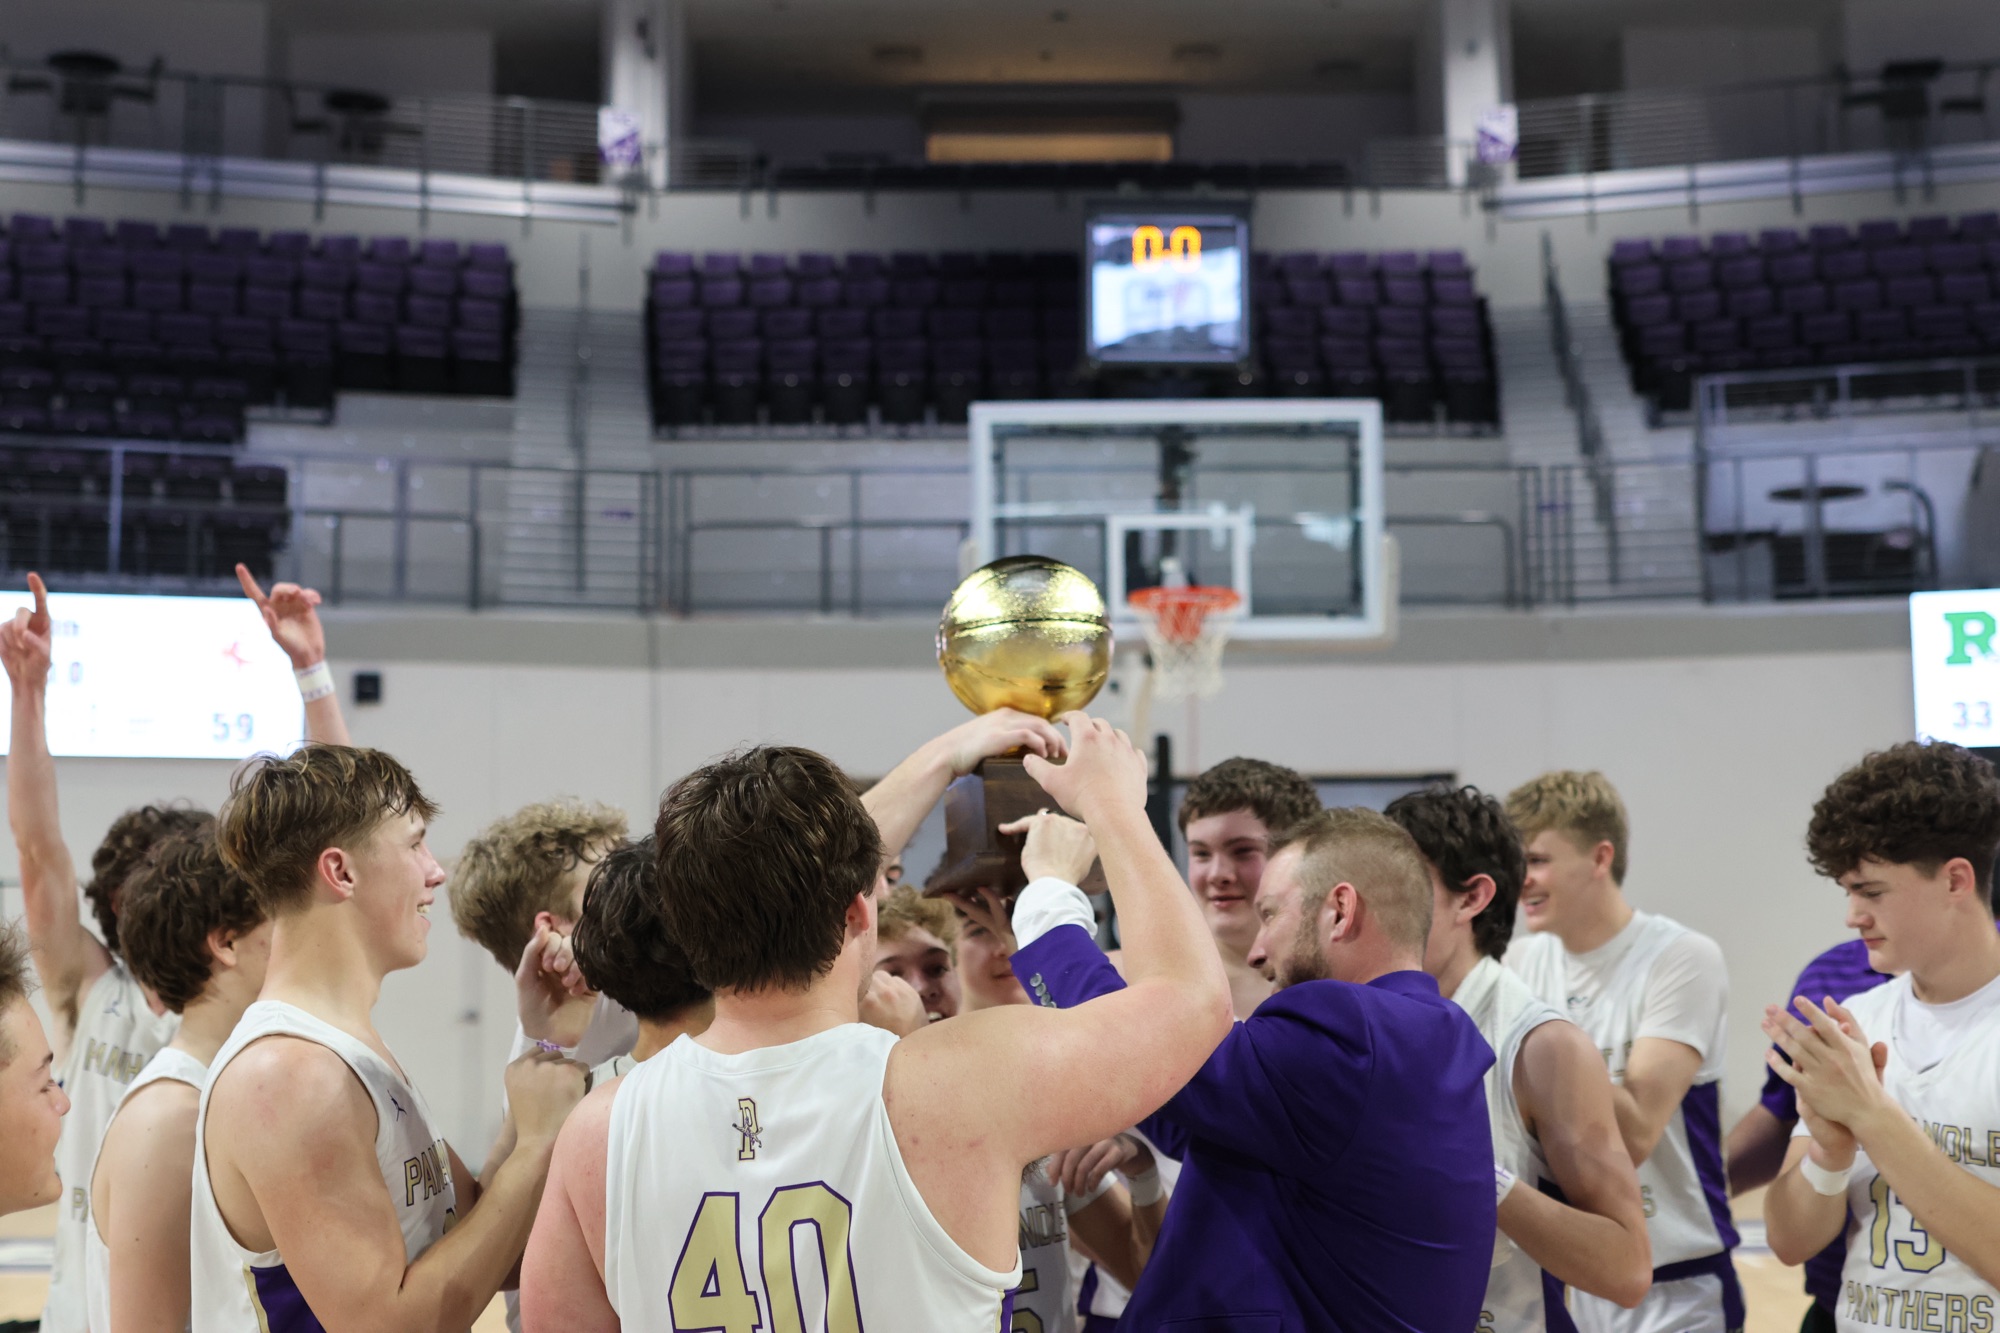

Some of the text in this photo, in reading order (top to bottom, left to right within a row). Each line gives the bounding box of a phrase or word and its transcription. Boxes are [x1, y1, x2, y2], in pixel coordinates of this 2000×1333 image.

[212, 712, 255, 742] 59
[1952, 701, 1991, 730] 33
[668, 1180, 865, 1333] 40
[1846, 1280, 1994, 1333] PANTHERS
